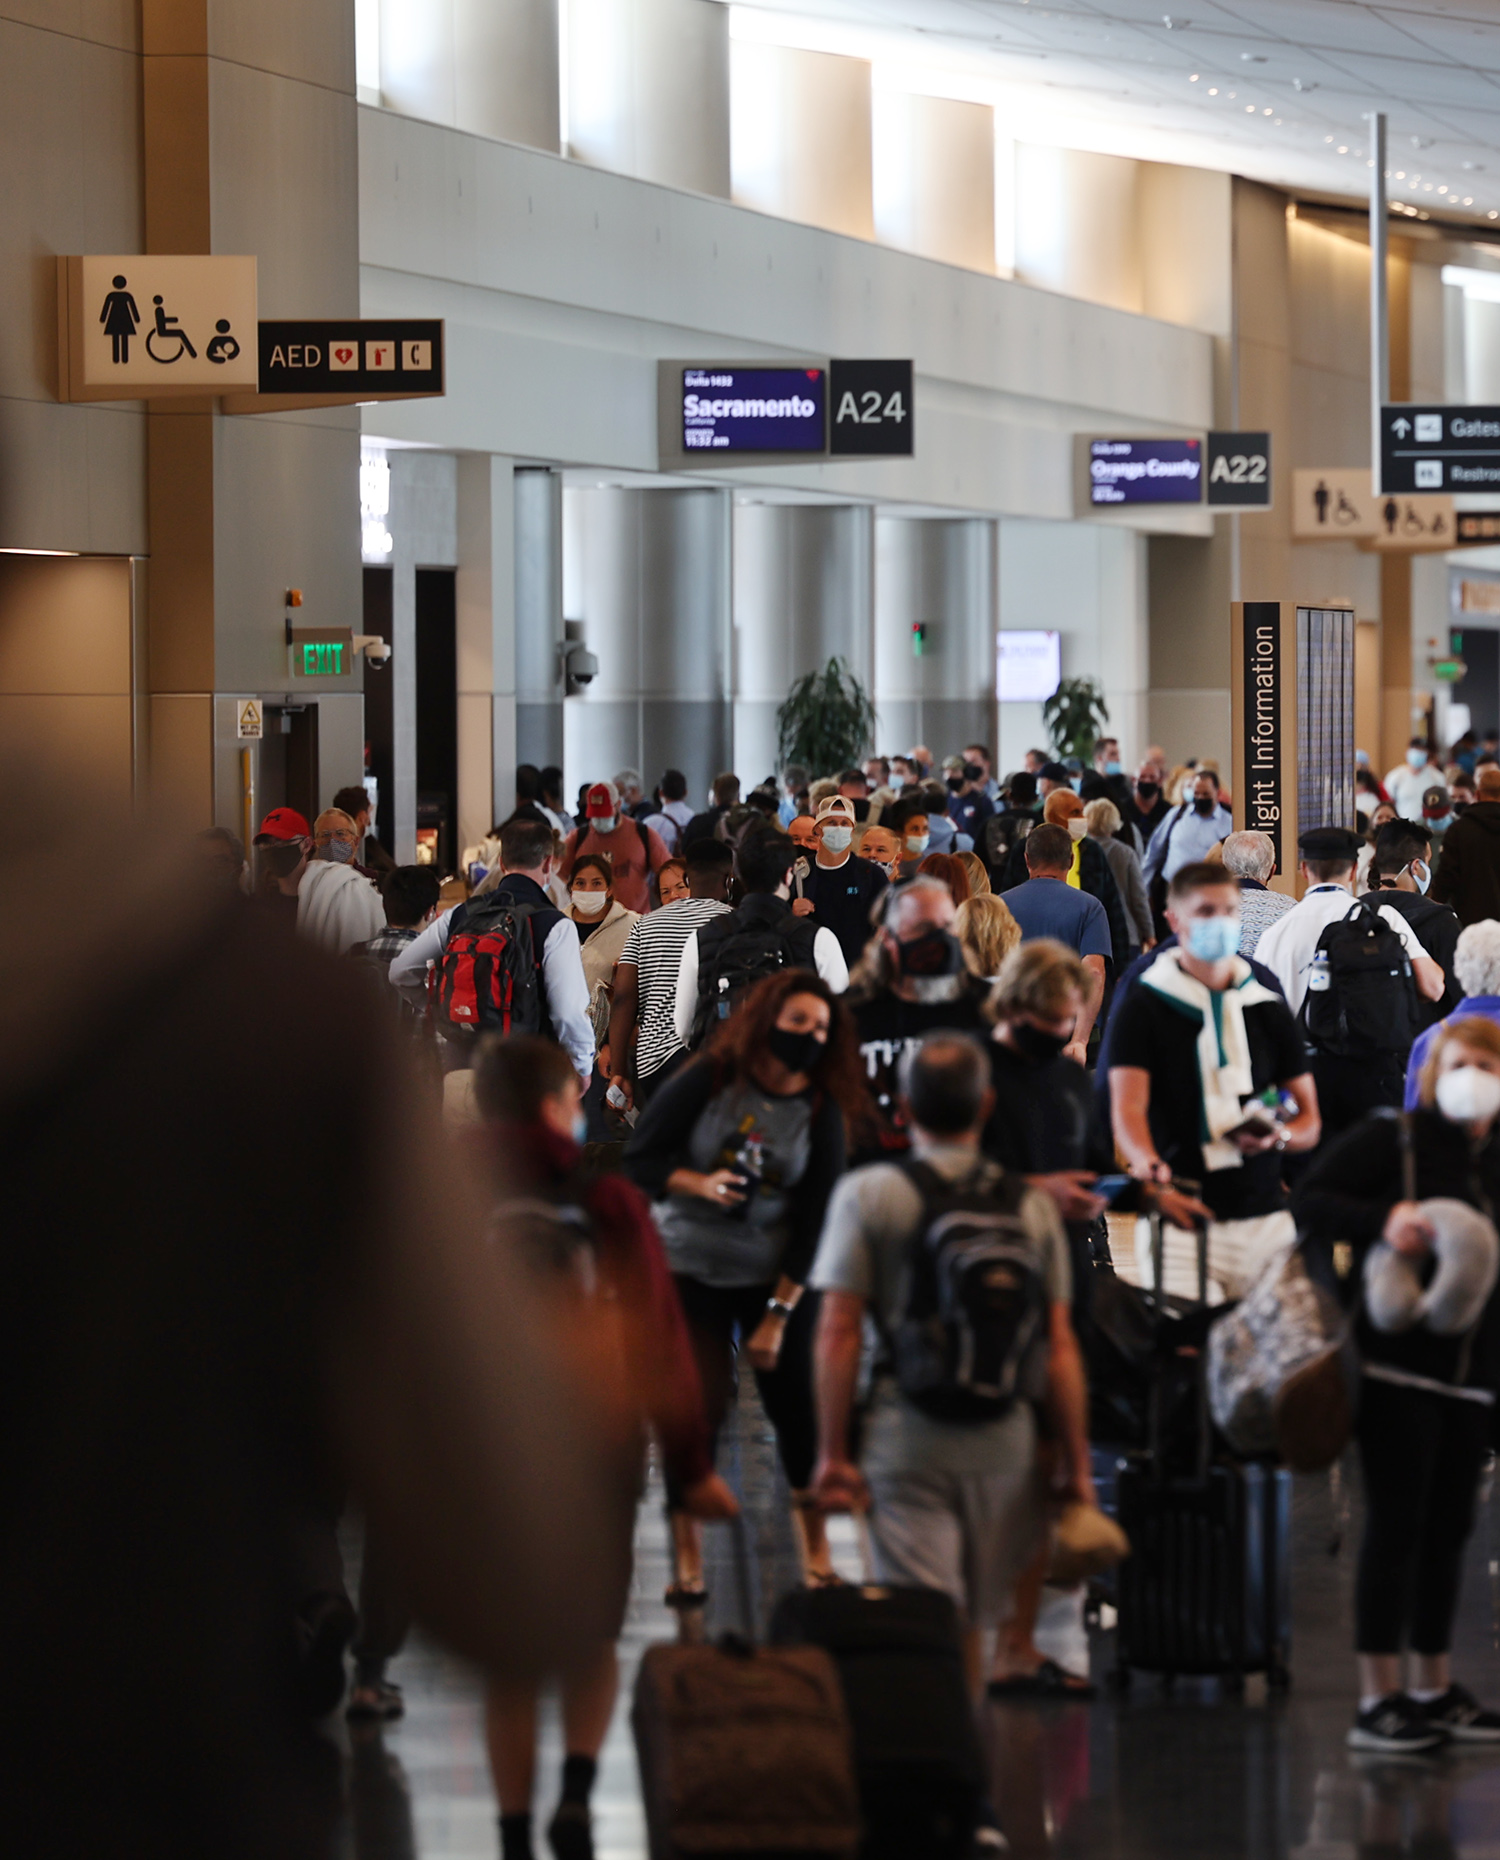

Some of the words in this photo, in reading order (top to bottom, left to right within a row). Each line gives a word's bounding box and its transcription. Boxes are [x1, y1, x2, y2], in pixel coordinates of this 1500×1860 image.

[270, 345, 322, 368] AED
[683, 393, 816, 418] Sacramento
[836, 391, 906, 424] A24
[1450, 418, 1500, 438] Gates
[1090, 458, 1146, 481] Orange
[1146, 457, 1200, 480] County
[1210, 454, 1267, 483] A22
[303, 643, 344, 674] EXIT
[1250, 625, 1274, 769] Information
